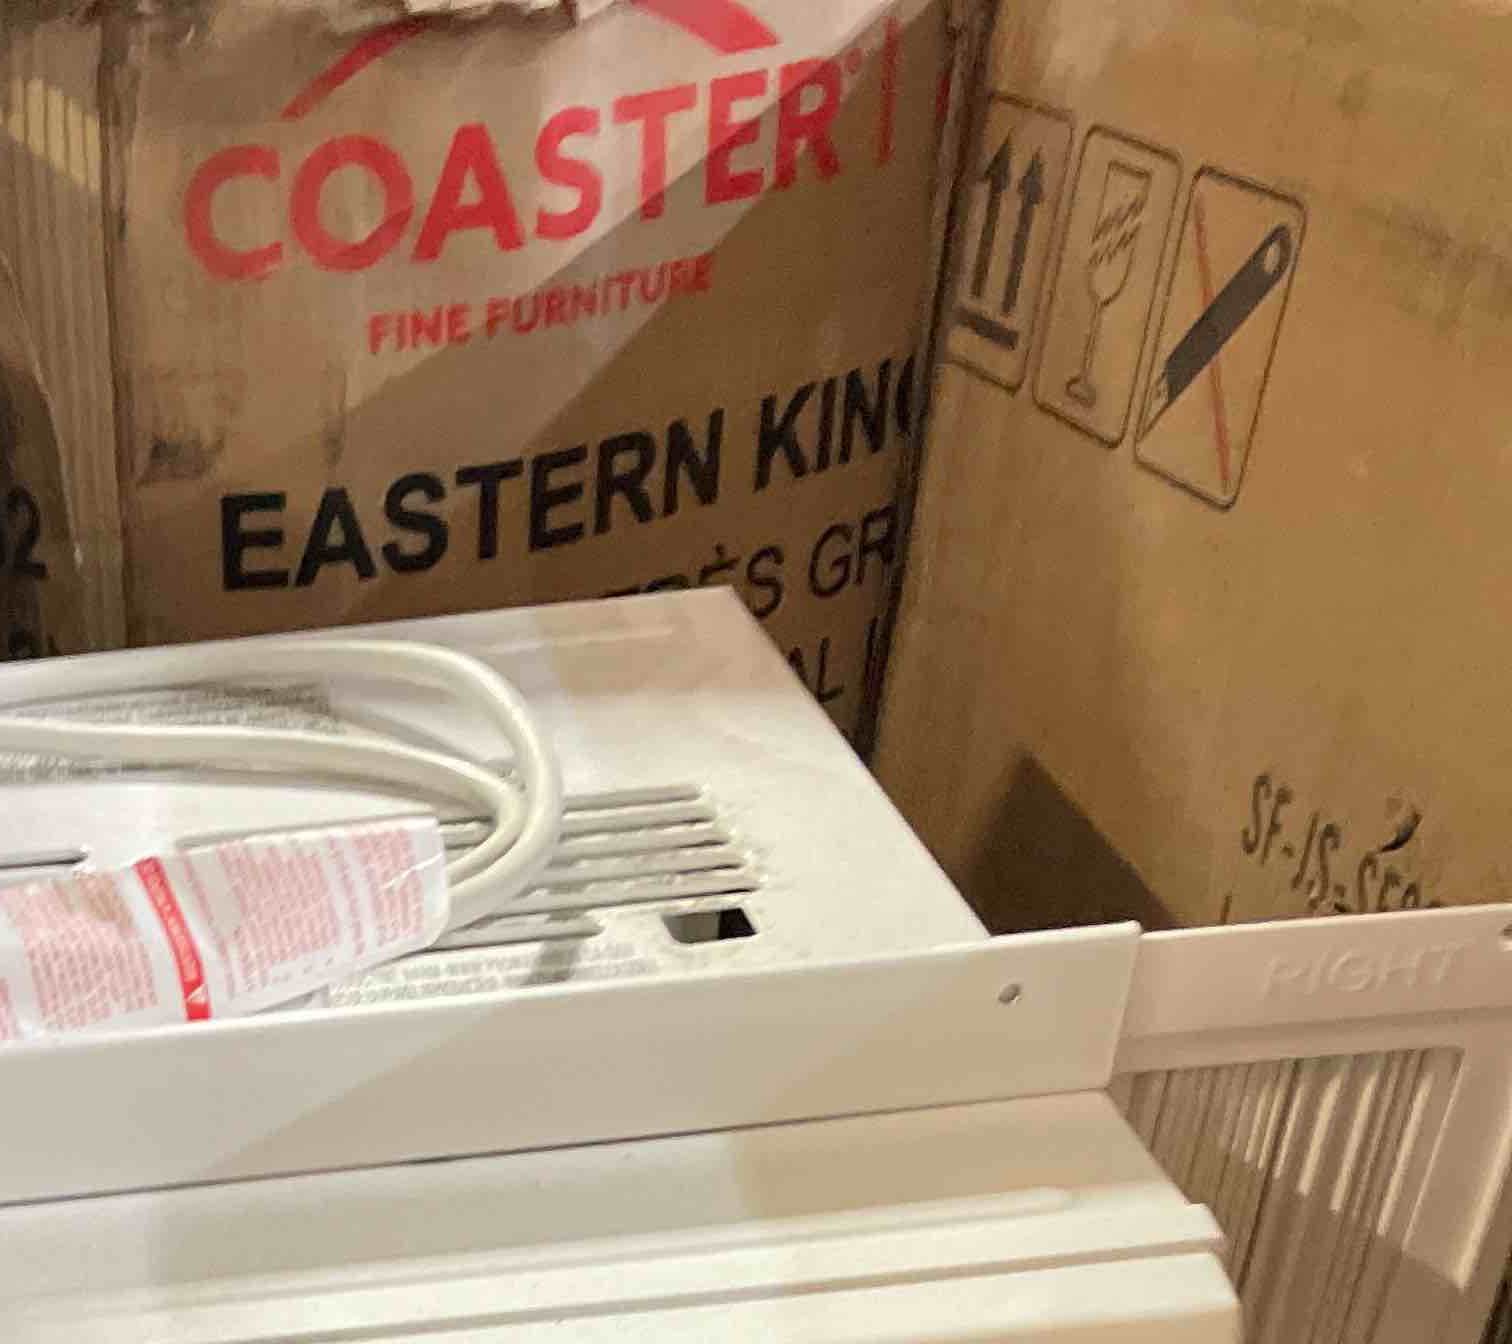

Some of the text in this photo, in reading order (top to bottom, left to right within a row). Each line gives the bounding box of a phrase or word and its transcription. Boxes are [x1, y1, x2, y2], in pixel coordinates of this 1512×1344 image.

[184, 57, 842, 283] COASTER
[368, 256, 715, 354] FINE FURNITURE
[220, 407, 725, 592] EASTERN
